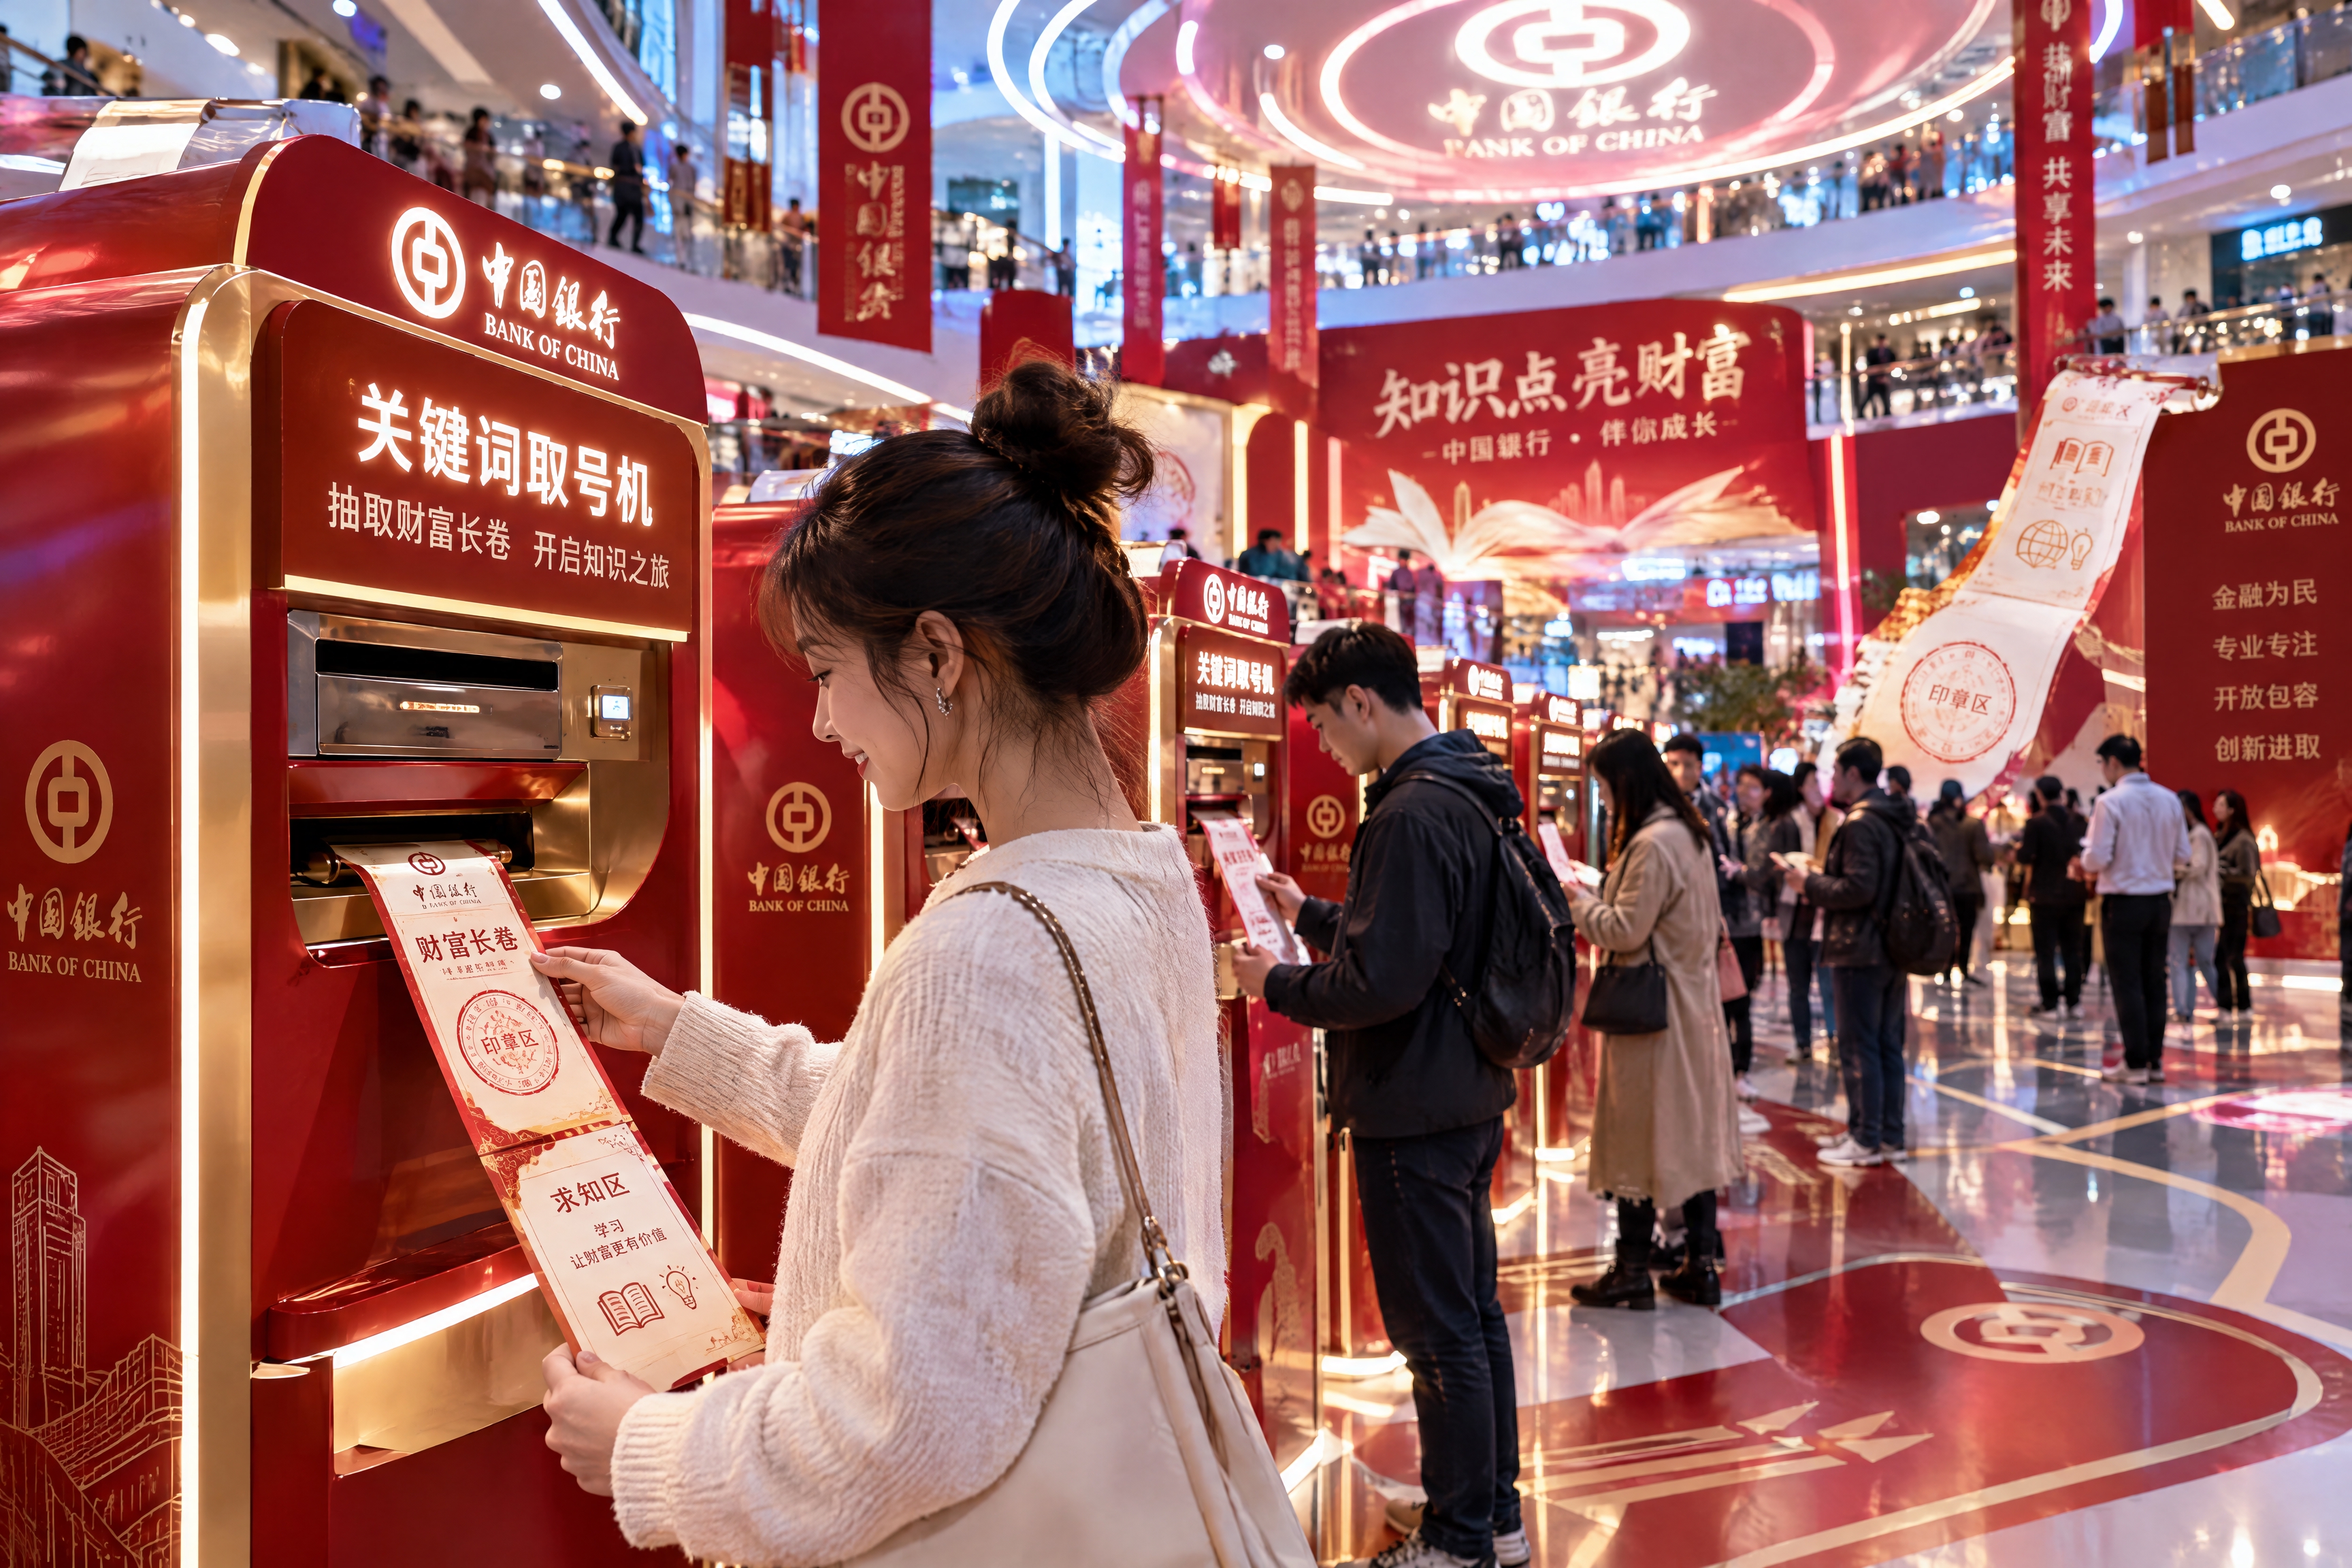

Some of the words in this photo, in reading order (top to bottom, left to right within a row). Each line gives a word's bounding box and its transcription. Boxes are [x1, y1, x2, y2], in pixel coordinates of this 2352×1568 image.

[1542, 135, 1588, 157] OF
[1595, 125, 1705, 152] CHINA
[2042, 156, 2073, 292] 共享未来
[485, 312, 535, 350] BANK
[539, 335, 561, 359] OF
[565, 344, 619, 380] CHINA
[1373, 323, 1752, 438] 知识点亮财富
[1599, 410, 1718, 448] 伴你成长
[357, 382, 653, 527] 关键词取号机
[328, 482, 511, 560] 抽取财富长卷
[534, 530, 670, 589] 开启知识之旅
[2225, 518, 2265, 533] BANK
[2268, 516, 2287, 529] OF
[2290, 512, 2340, 527] CHINA
[2212, 578, 2317, 610] 金融为民
[2213, 630, 2319, 661] 专业专注
[1197, 651, 1275, 695] 关键词取号机
[1928, 685, 1992, 715] 印章区
[2214, 681, 2319, 711] 开放包容
[2215, 733, 2321, 762] 创新进取
[749, 900, 784, 911] BANK
[787, 900, 804, 911] OF
[806, 900, 849, 911] CHINA
[8, 951, 52, 974] BANK
[56, 956, 78, 977] OF
[83, 959, 142, 983] CHINA
[480, 1029, 539, 1055] 印章区
[550, 1172, 630, 1213] 求知区
[593, 1219, 624, 1238] 学习
[570, 1228, 667, 1269] 让财富更有价值
